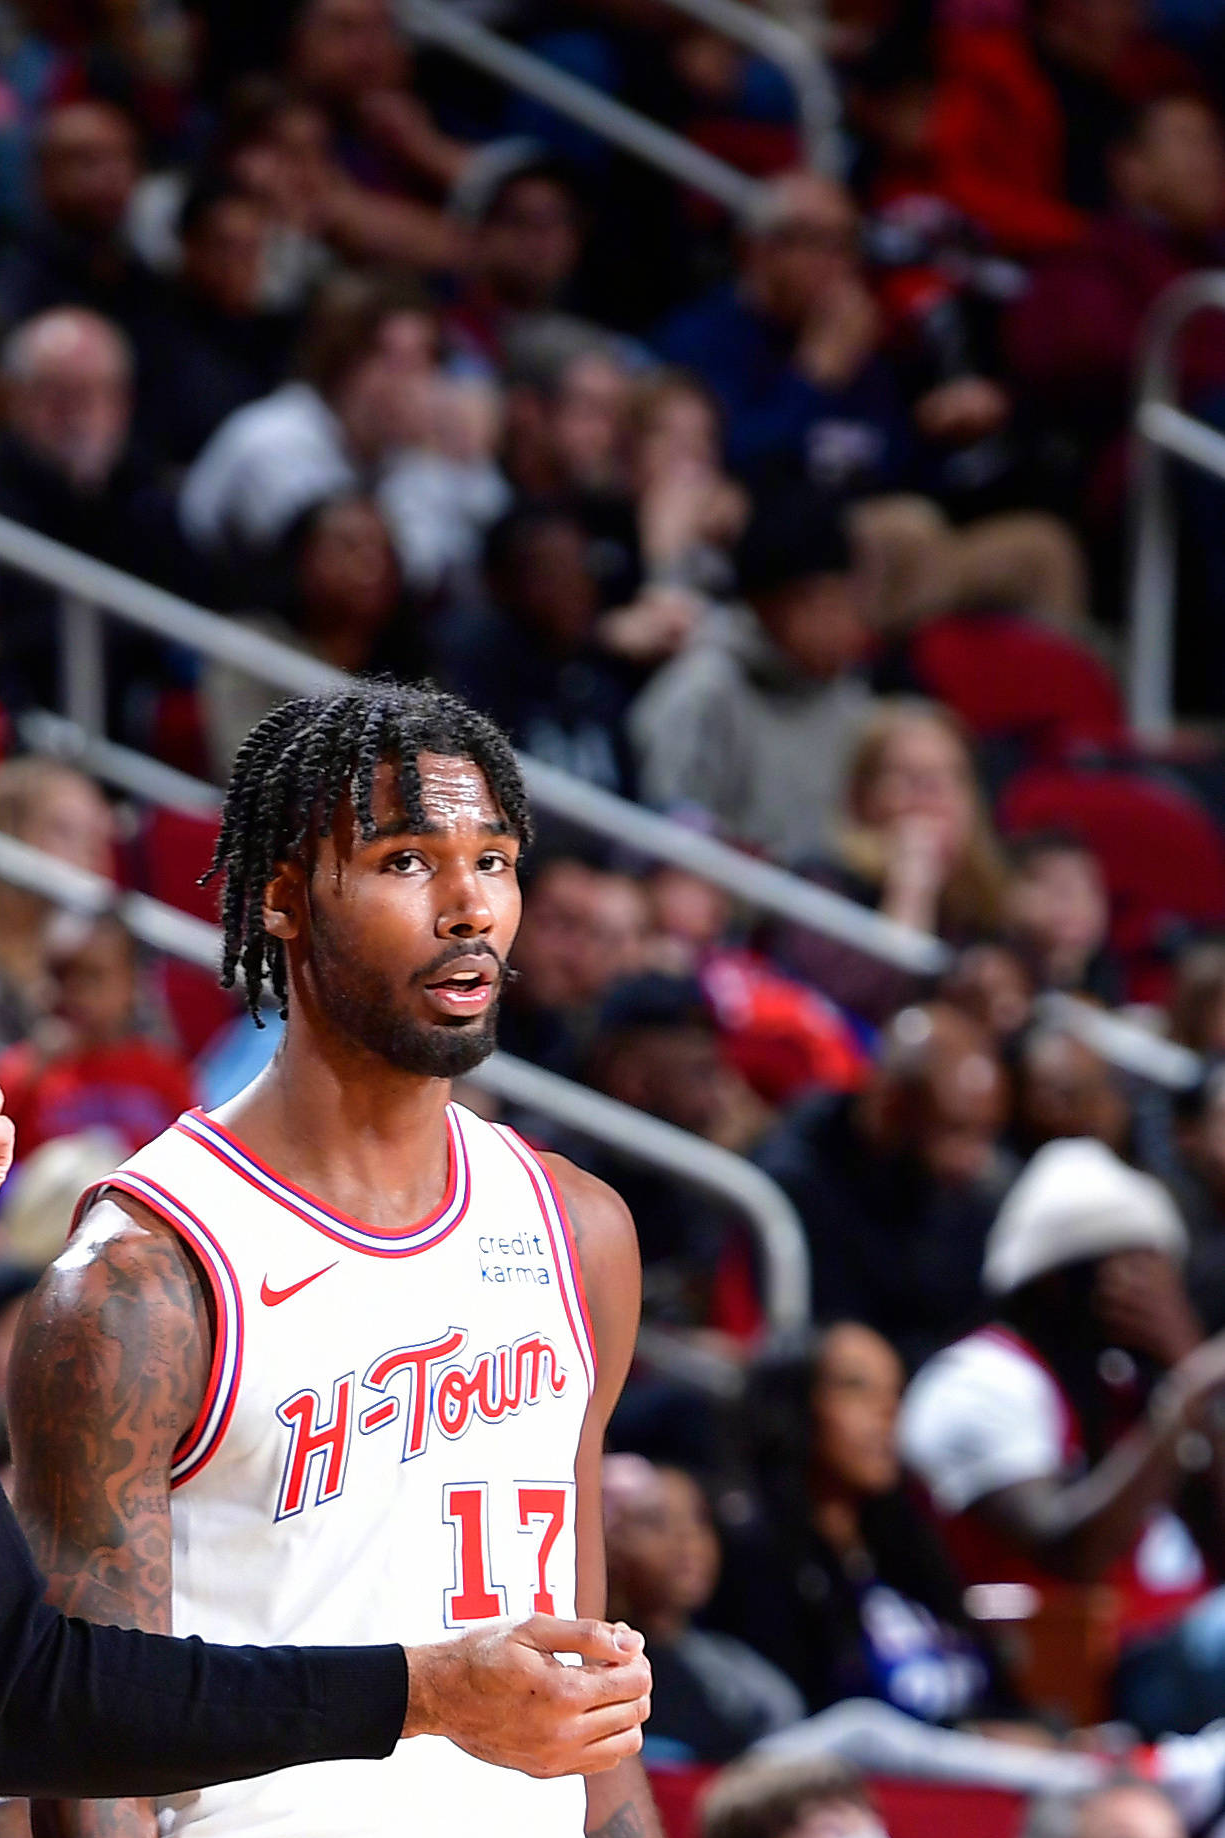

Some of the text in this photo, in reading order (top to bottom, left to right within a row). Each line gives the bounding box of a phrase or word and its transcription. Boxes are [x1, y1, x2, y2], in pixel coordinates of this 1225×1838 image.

[478, 1231, 544, 1255] credit
[478, 1256, 550, 1285] karma
[273, 1325, 570, 1524] H-Town
[442, 1480, 576, 1629] 17
